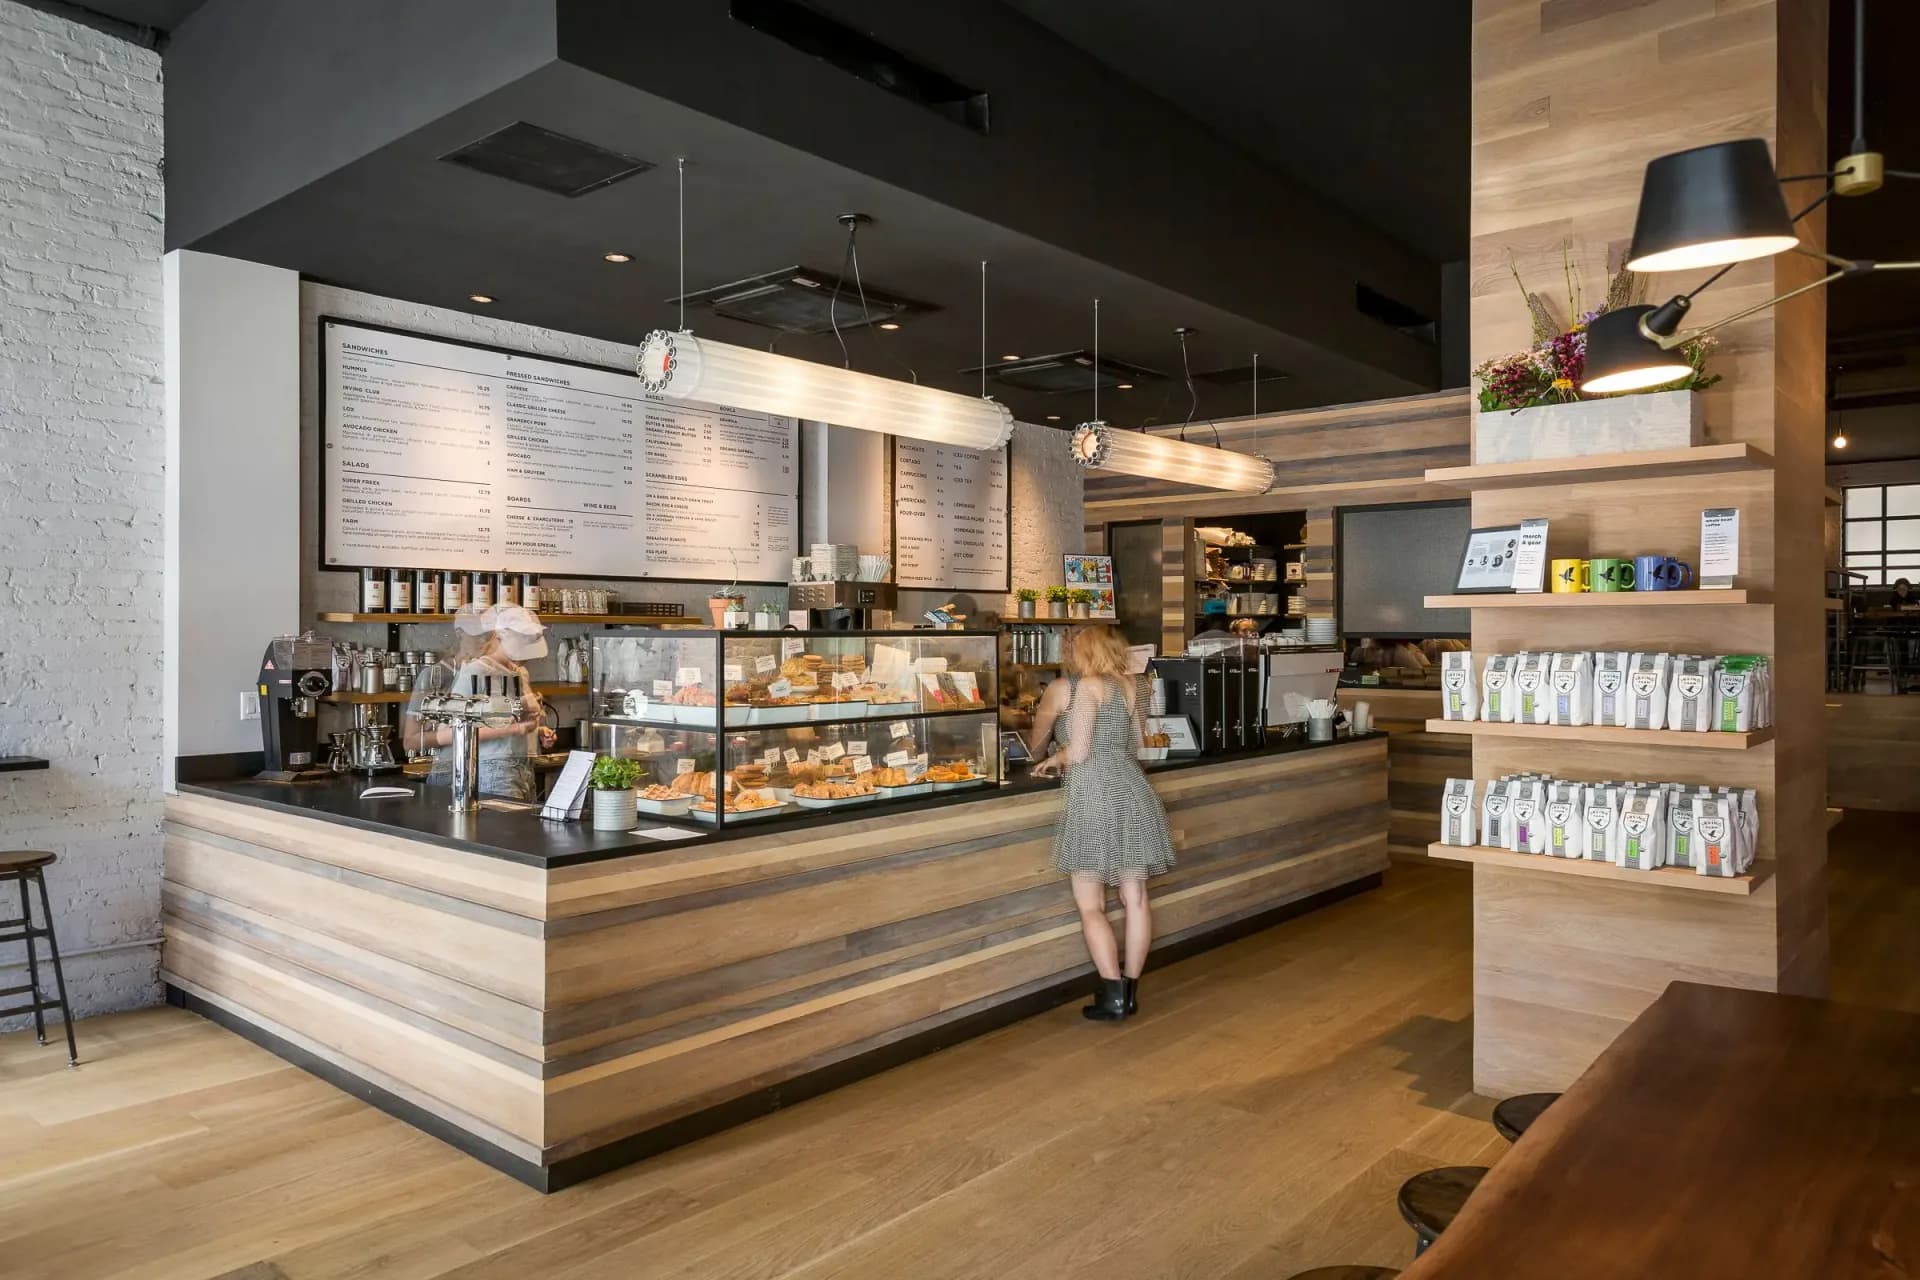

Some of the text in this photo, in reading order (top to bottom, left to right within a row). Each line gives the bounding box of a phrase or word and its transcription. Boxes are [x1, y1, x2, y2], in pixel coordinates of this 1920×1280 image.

[342, 343, 388, 355] SANDWICHES
[342, 364, 367, 373] HUMMUS
[506, 370, 570, 386] PRESSED SANDWICHES
[342, 385, 363, 393] IRVING
[342, 423, 372, 431] AVOCADO
[373, 426, 398, 434] CHICKEN
[342, 460, 370, 468] SALADS
[368, 499, 393, 507] CHICKEN
